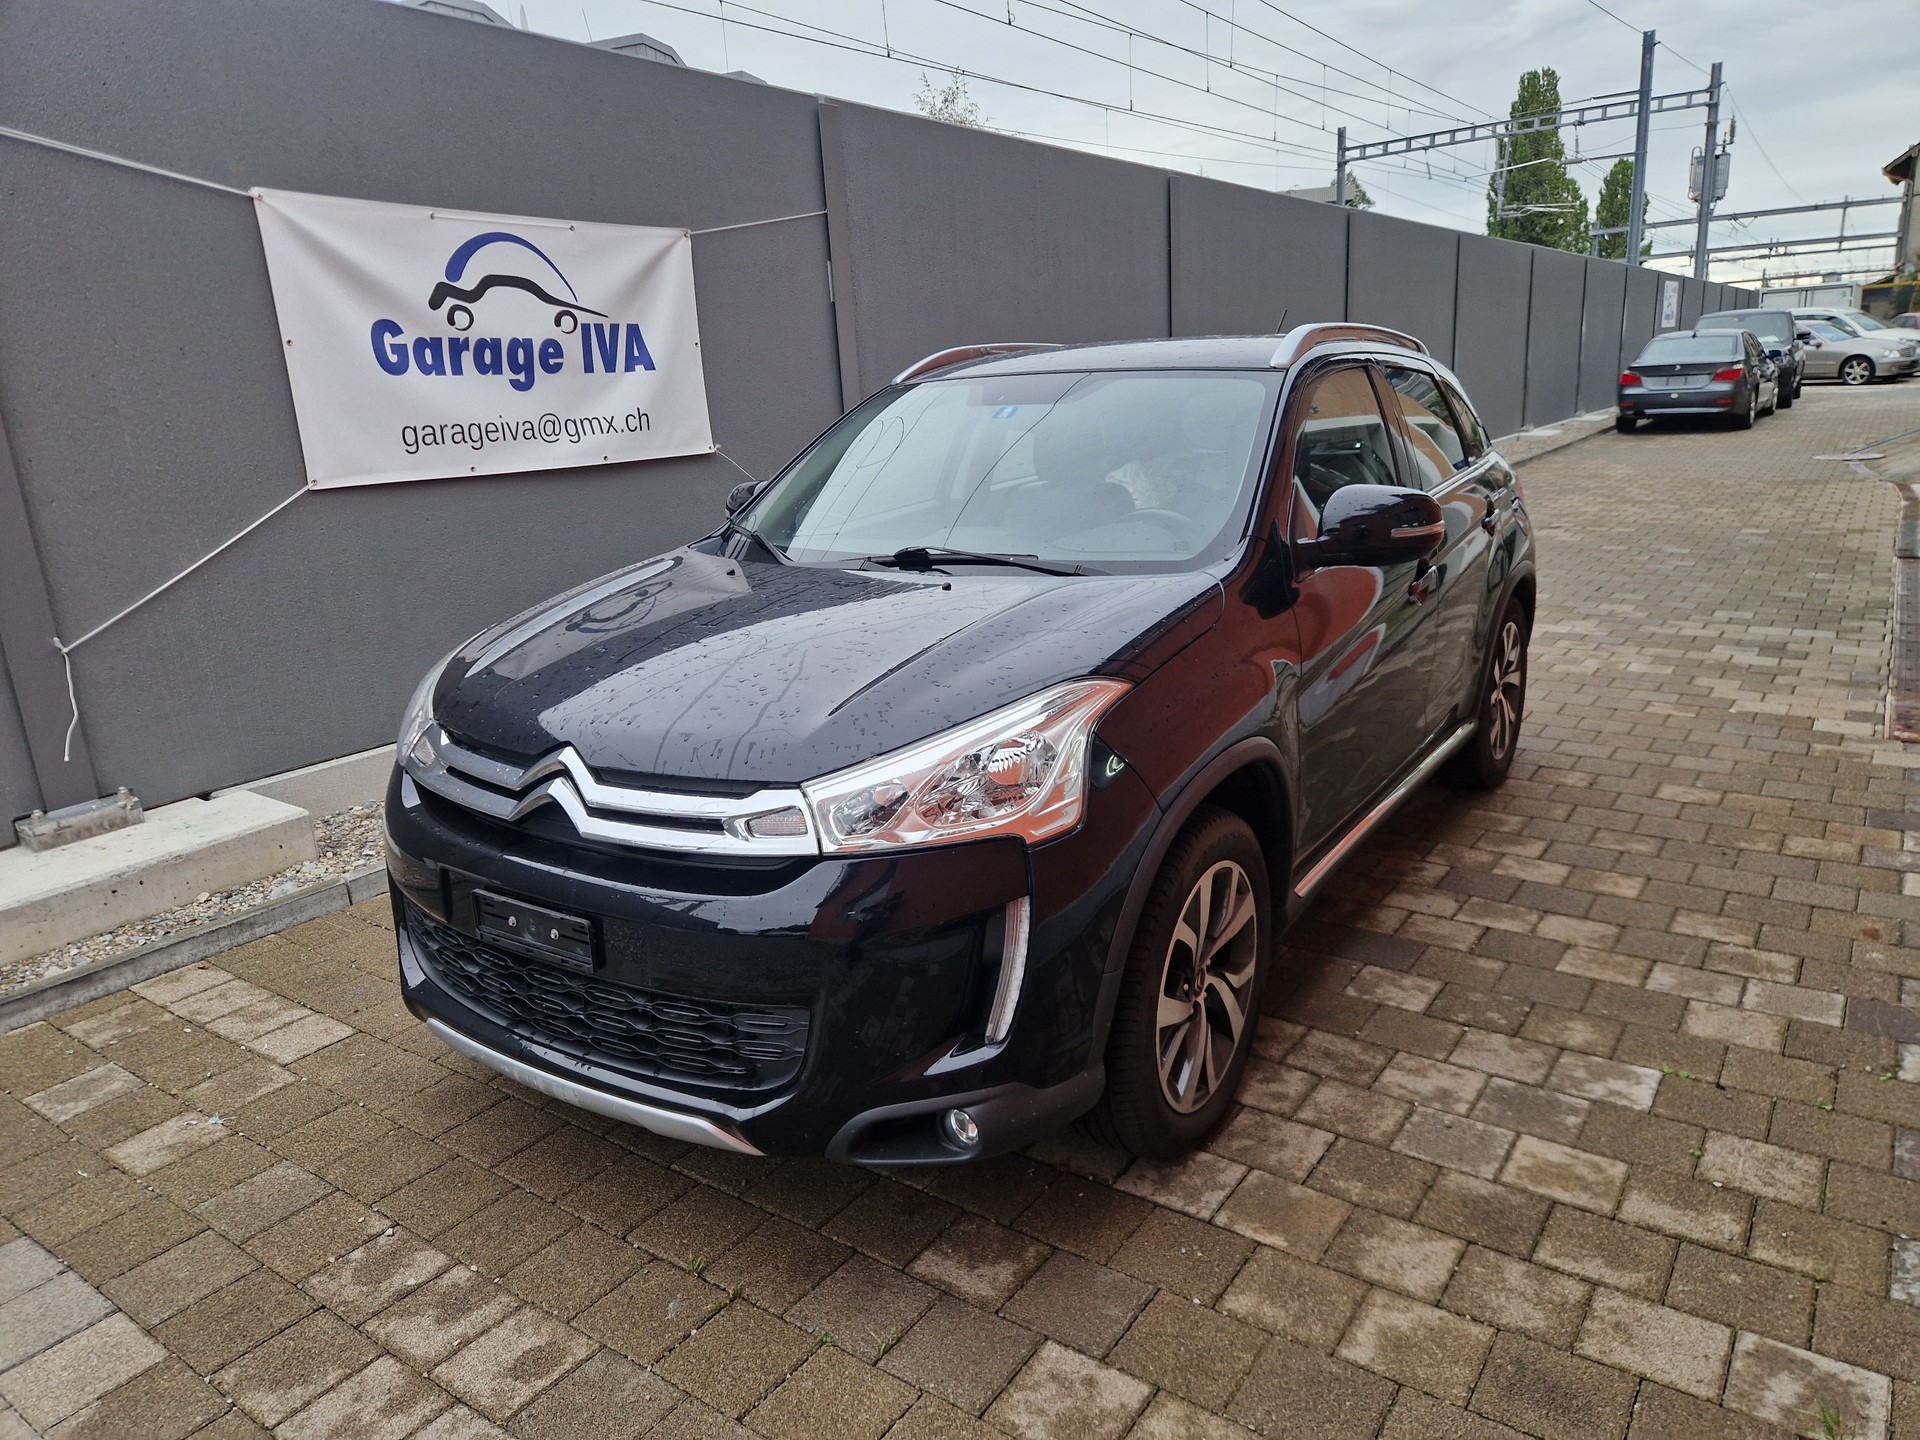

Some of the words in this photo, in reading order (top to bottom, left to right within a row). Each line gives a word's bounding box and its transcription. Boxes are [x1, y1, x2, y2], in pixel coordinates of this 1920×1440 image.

[371, 319, 564, 391] Garage
[581, 323, 656, 374] IVA
[401, 407, 651, 454] garageiva@gmx.ch
